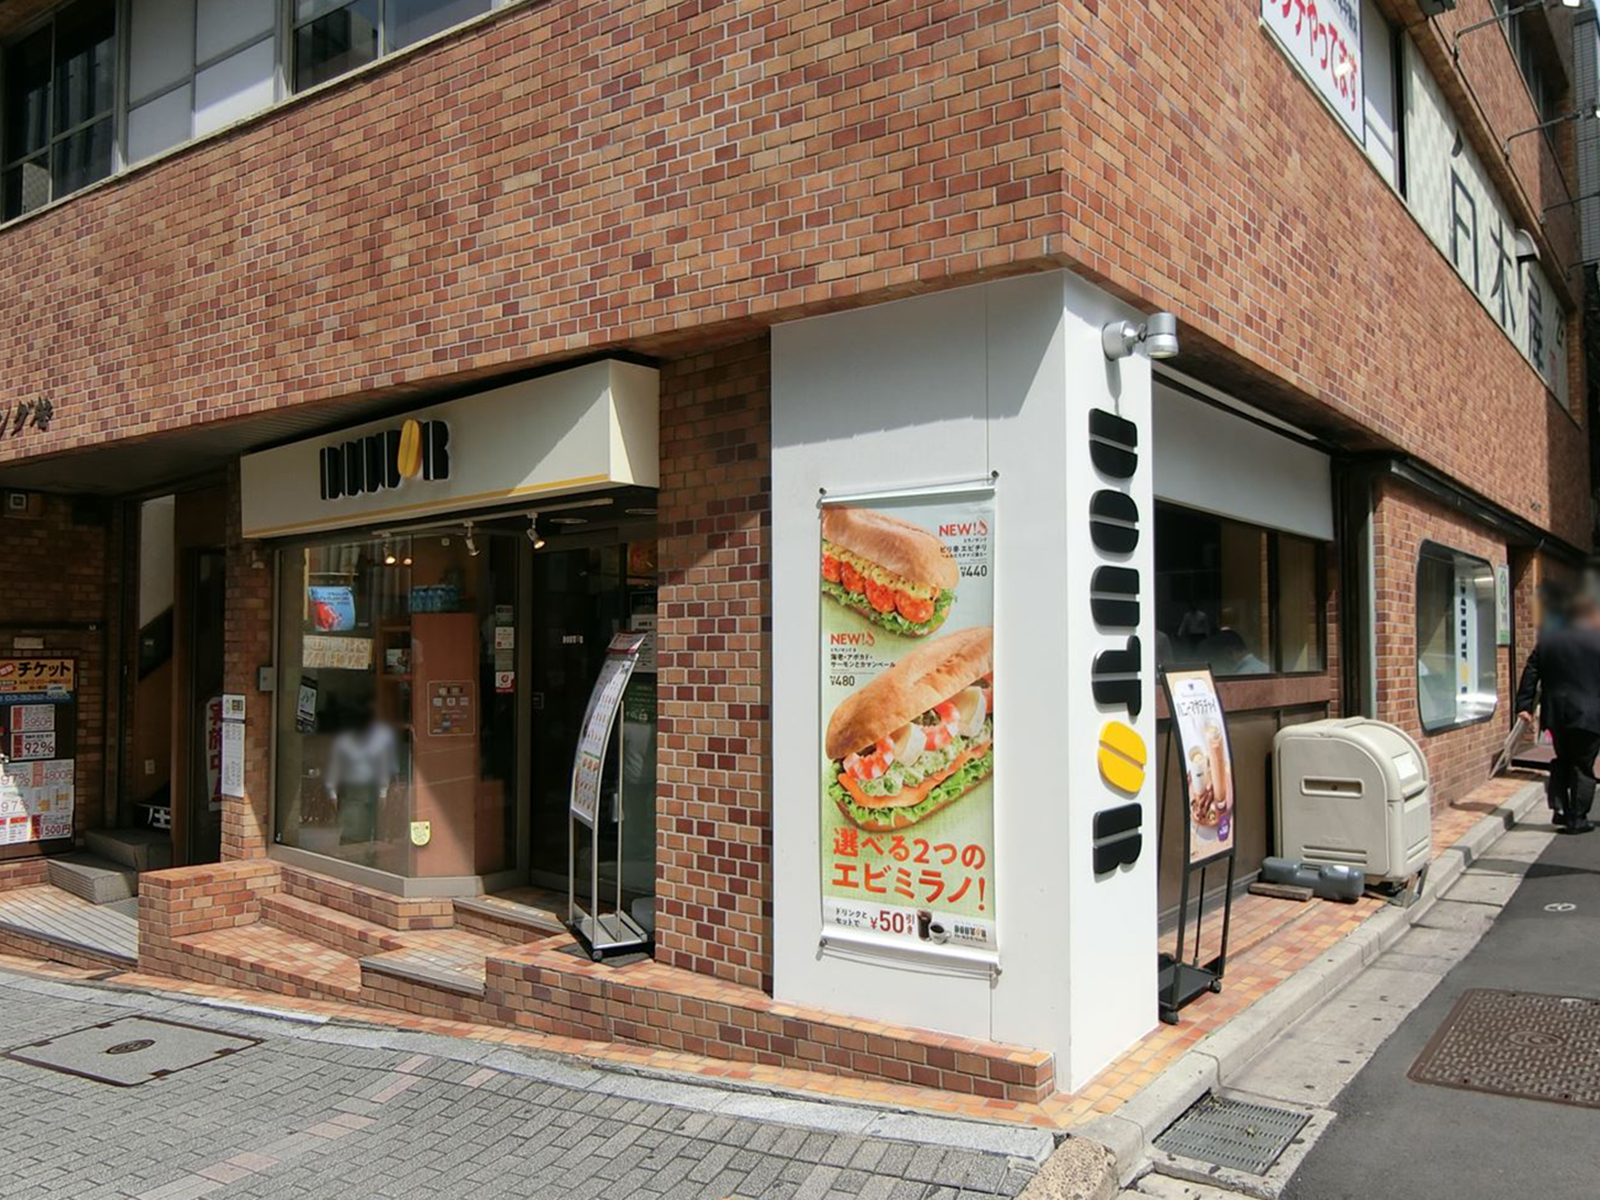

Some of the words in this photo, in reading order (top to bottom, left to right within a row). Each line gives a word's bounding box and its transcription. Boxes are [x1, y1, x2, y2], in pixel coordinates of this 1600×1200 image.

[319, 418, 449, 500] DOUTOR
[939, 522, 977, 537] NEW!
[830, 633, 865, 645] NEW!
[1089, 407, 1148, 875] DOUTOR
[18, 661, 71, 677] チケット
[24, 742, 55, 754] 92%
[833, 826, 986, 870] 選べる2つの
[832, 862, 985, 911] エビミラノ!
[835, 906, 867, 919] ドリンクと
[836, 917, 861, 928] セットで
